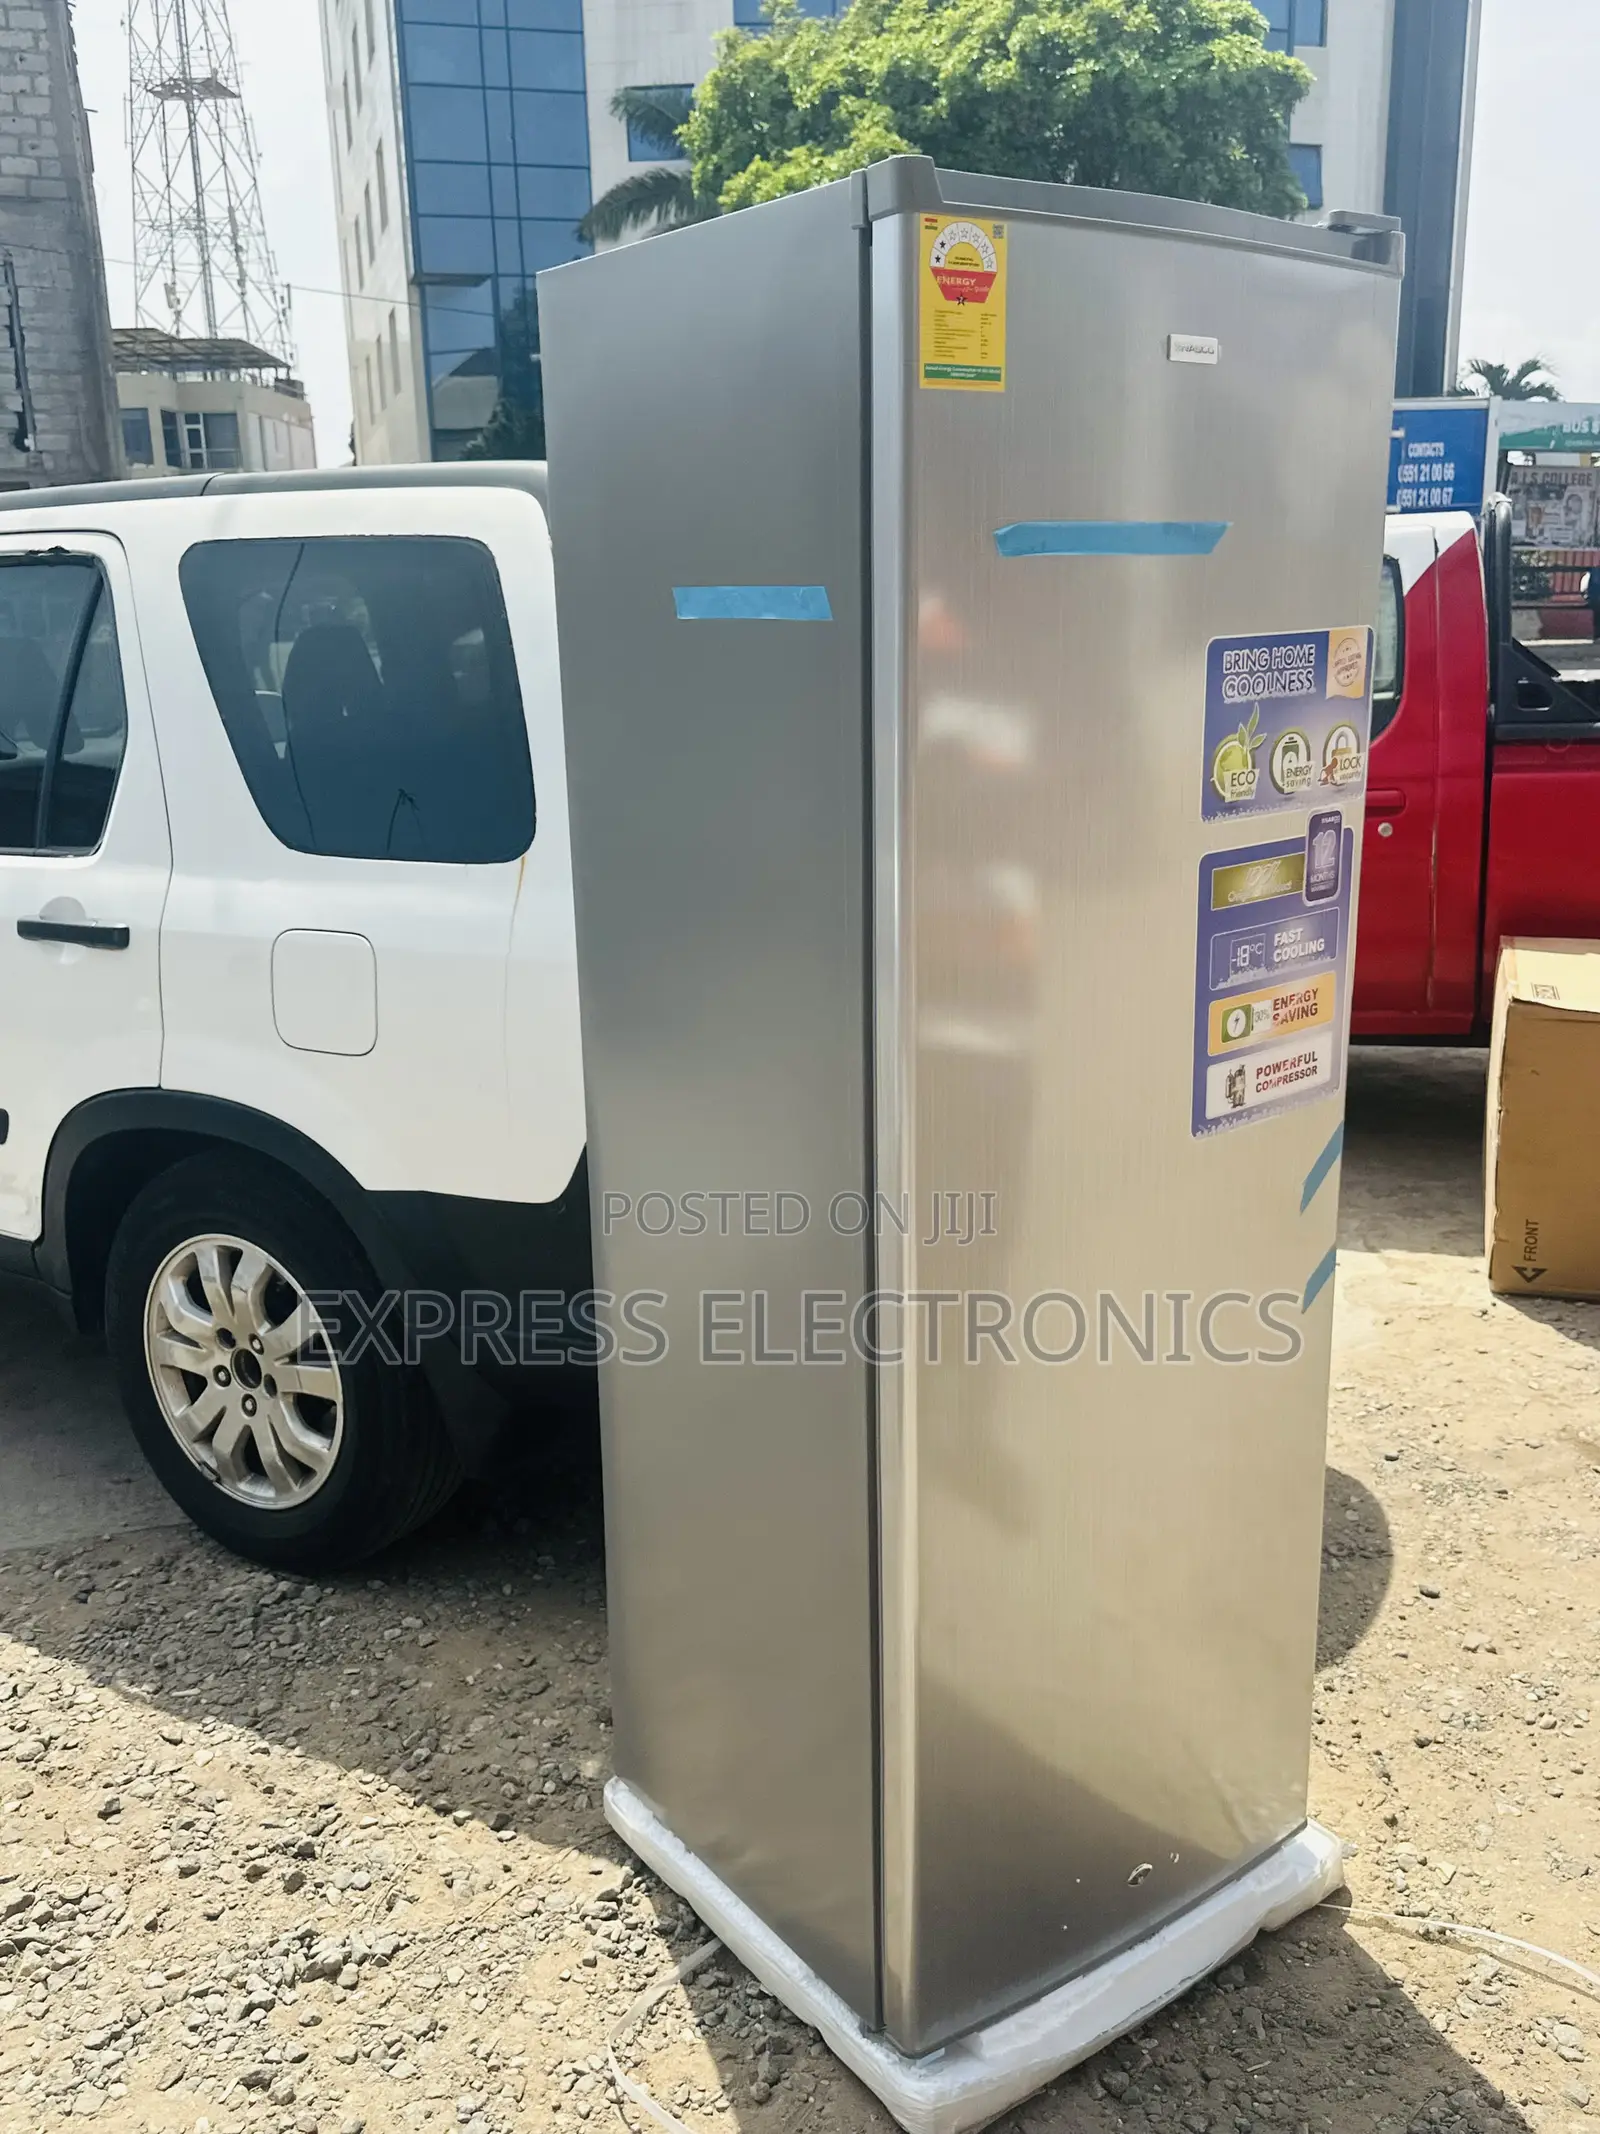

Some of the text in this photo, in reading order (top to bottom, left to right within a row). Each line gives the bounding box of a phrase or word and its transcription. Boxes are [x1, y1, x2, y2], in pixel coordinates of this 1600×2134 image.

[937, 275, 976, 286] ENERGY
[1562, 420, 1589, 434] BUS
[1420, 463, 1430, 482] 21
[1432, 463, 1442, 481] 00
[1541, 472, 1593, 487] COLLEGE
[1418, 488, 1429, 507] 21
[1430, 487, 1441, 506] 00
[1442, 487, 1453, 505] 67
[1223, 648, 1270, 674] BRING
[1272, 644, 1315, 669] HOME
[1222, 668, 1315, 702] COOLNESS
[1286, 765, 1313, 778] ENERGY
[1339, 756, 1362, 771] LOCK
[1231, 770, 1256, 787] ECO
[1286, 777, 1311, 788] saving
[1312, 829, 1337, 869] 12
[1274, 928, 1304, 947] FAST
[1273, 938, 1325, 963] COOLING
[1273, 988, 1319, 1011] ENERGY
[1272, 1003, 1318, 1026] SAVING
[1256, 1051, 1318, 1079] POWERFUL
[1255, 1065, 1318, 1093] COMPRESSOR
[1524, 1218, 1540, 1261] FRONT
